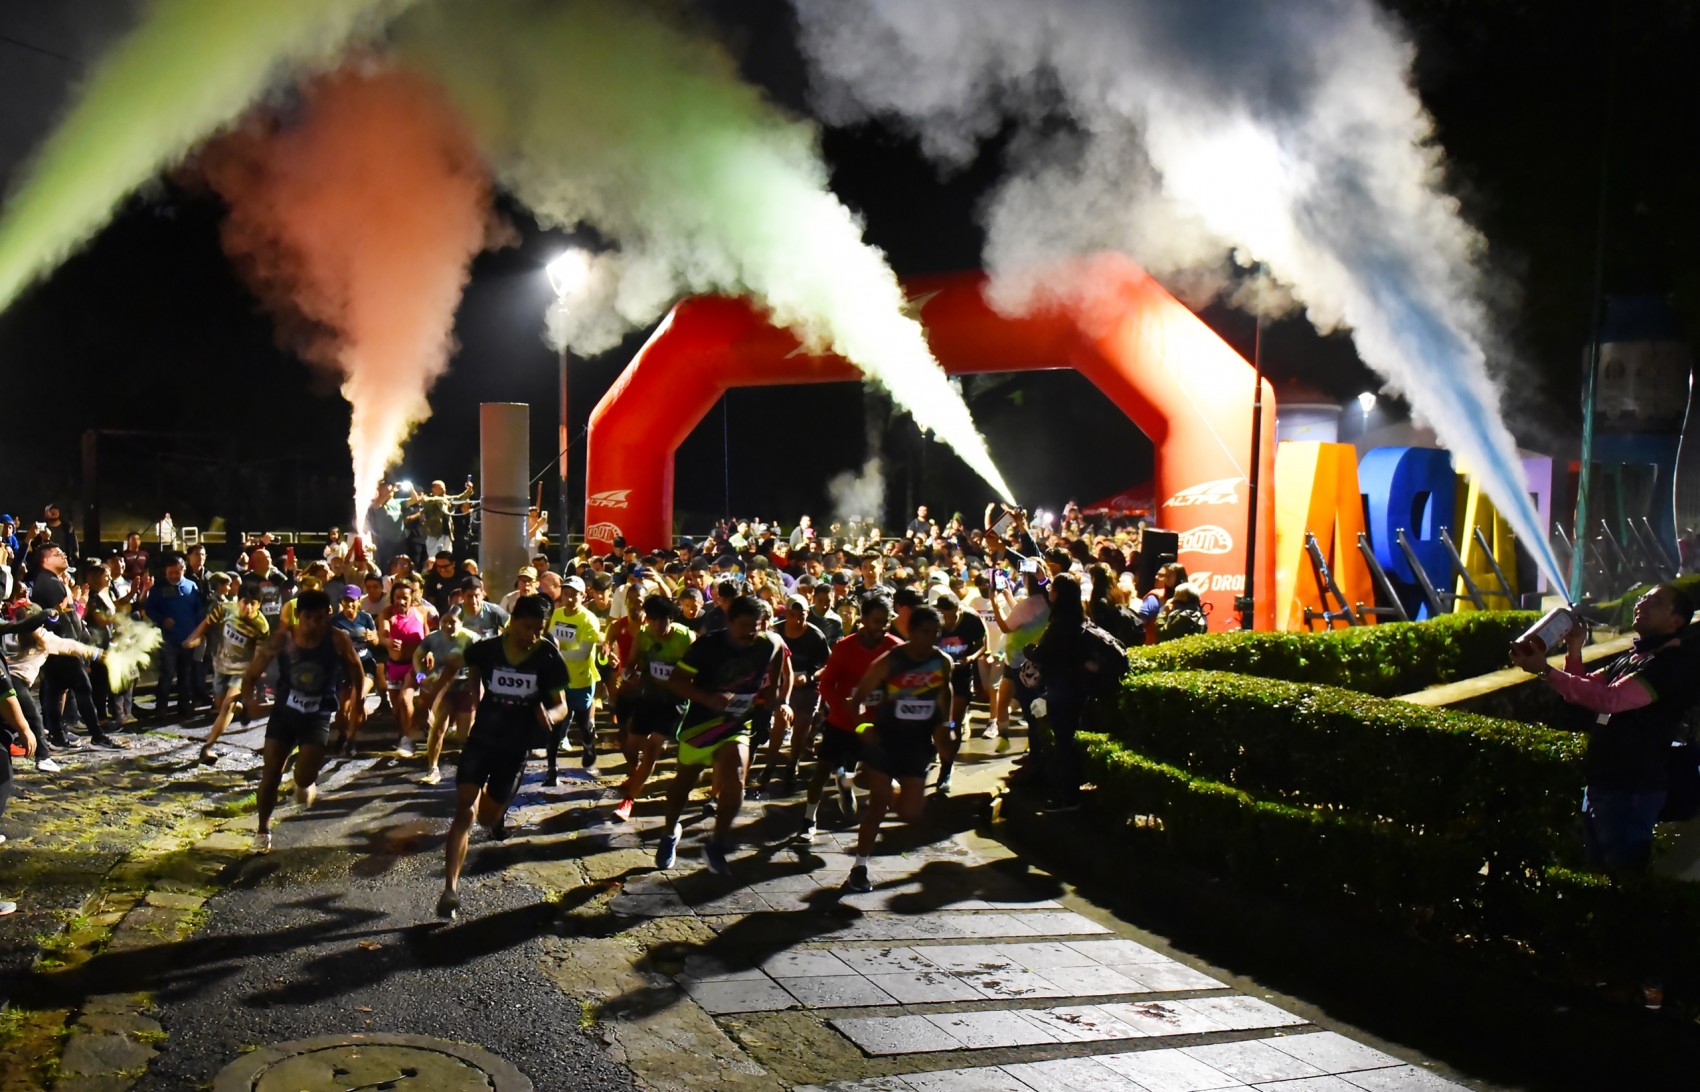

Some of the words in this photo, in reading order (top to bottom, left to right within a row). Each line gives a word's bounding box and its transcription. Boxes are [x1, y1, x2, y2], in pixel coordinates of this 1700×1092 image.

[1162, 494, 1238, 508] ALTRA
[556, 629, 574, 639] 1117
[497, 676, 531, 689] 0391
